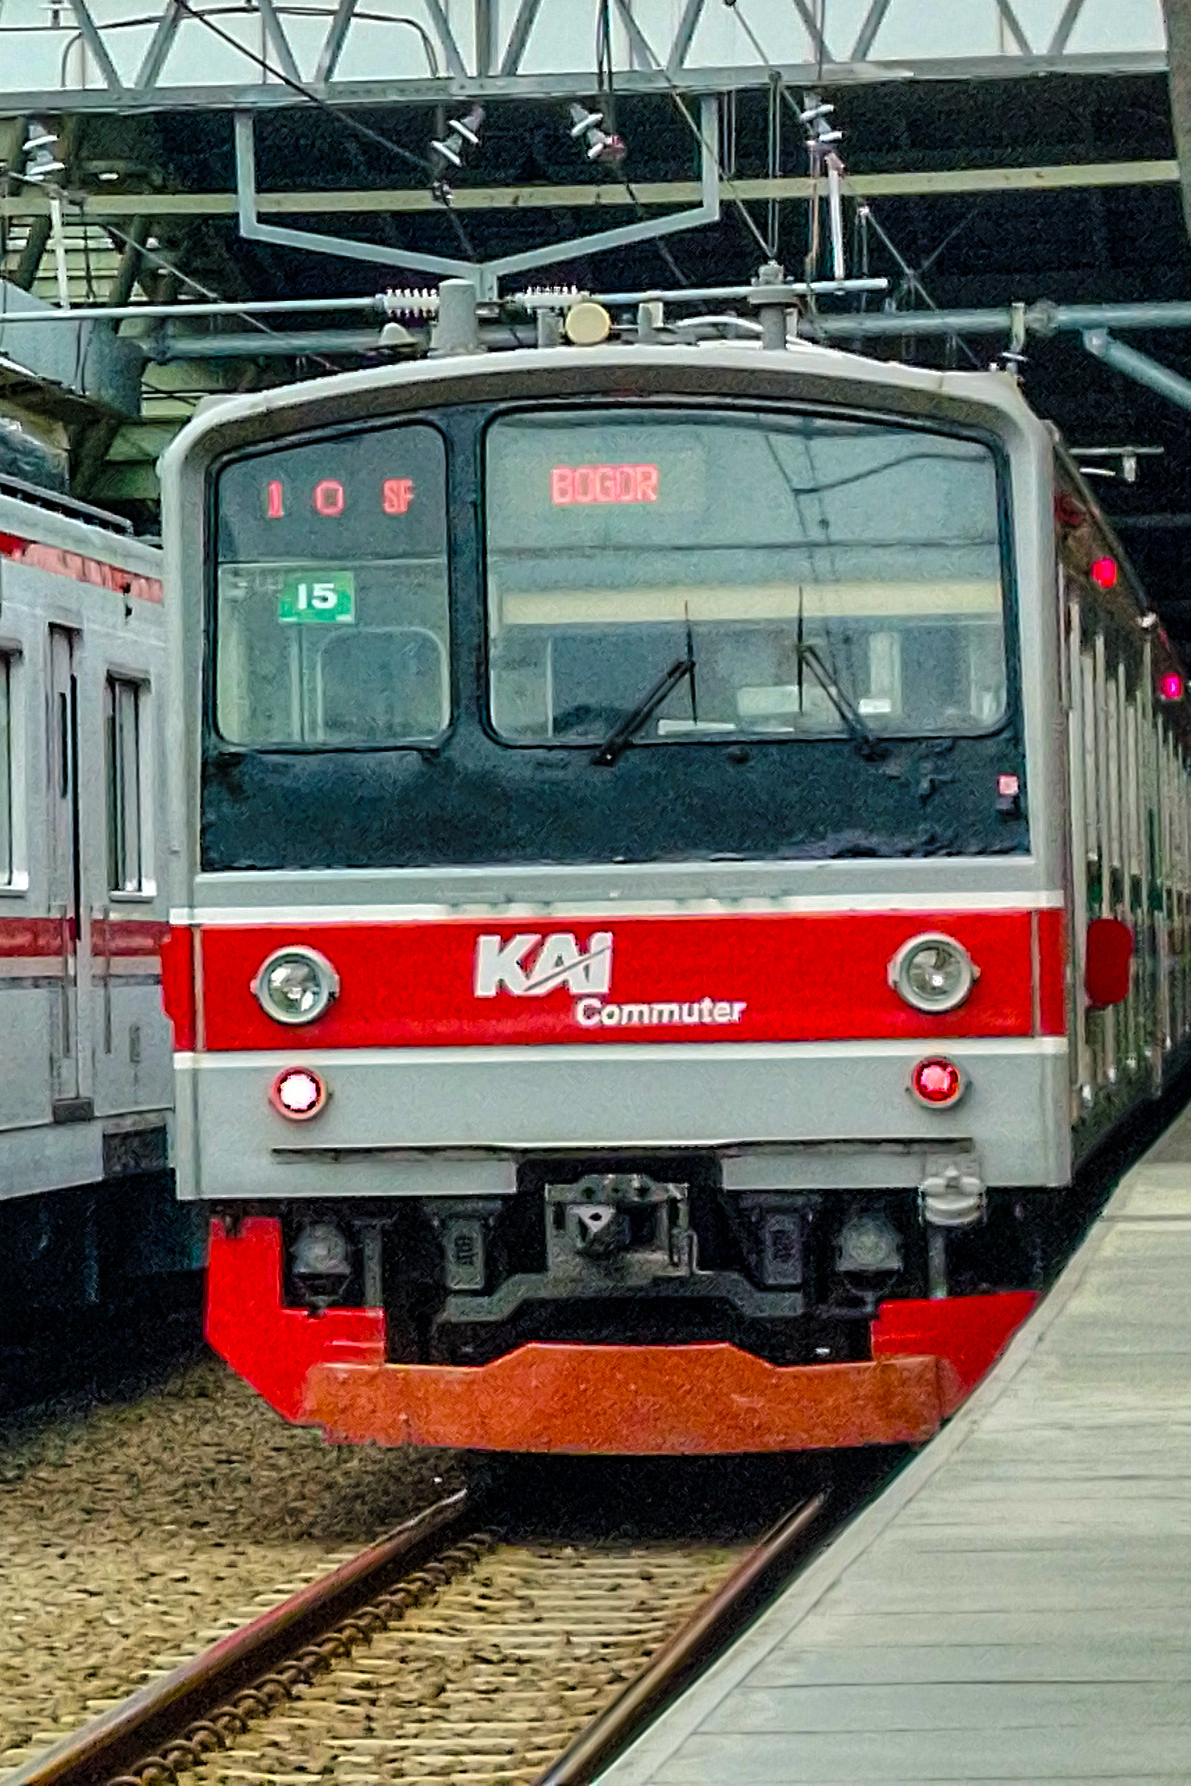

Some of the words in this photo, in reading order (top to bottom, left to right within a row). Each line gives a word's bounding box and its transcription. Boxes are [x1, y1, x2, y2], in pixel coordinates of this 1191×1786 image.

[552, 464, 658, 505] BOGOR
[297, 583, 338, 610] 15
[474, 931, 613, 998] KAI
[576, 996, 748, 1027] Commuter
